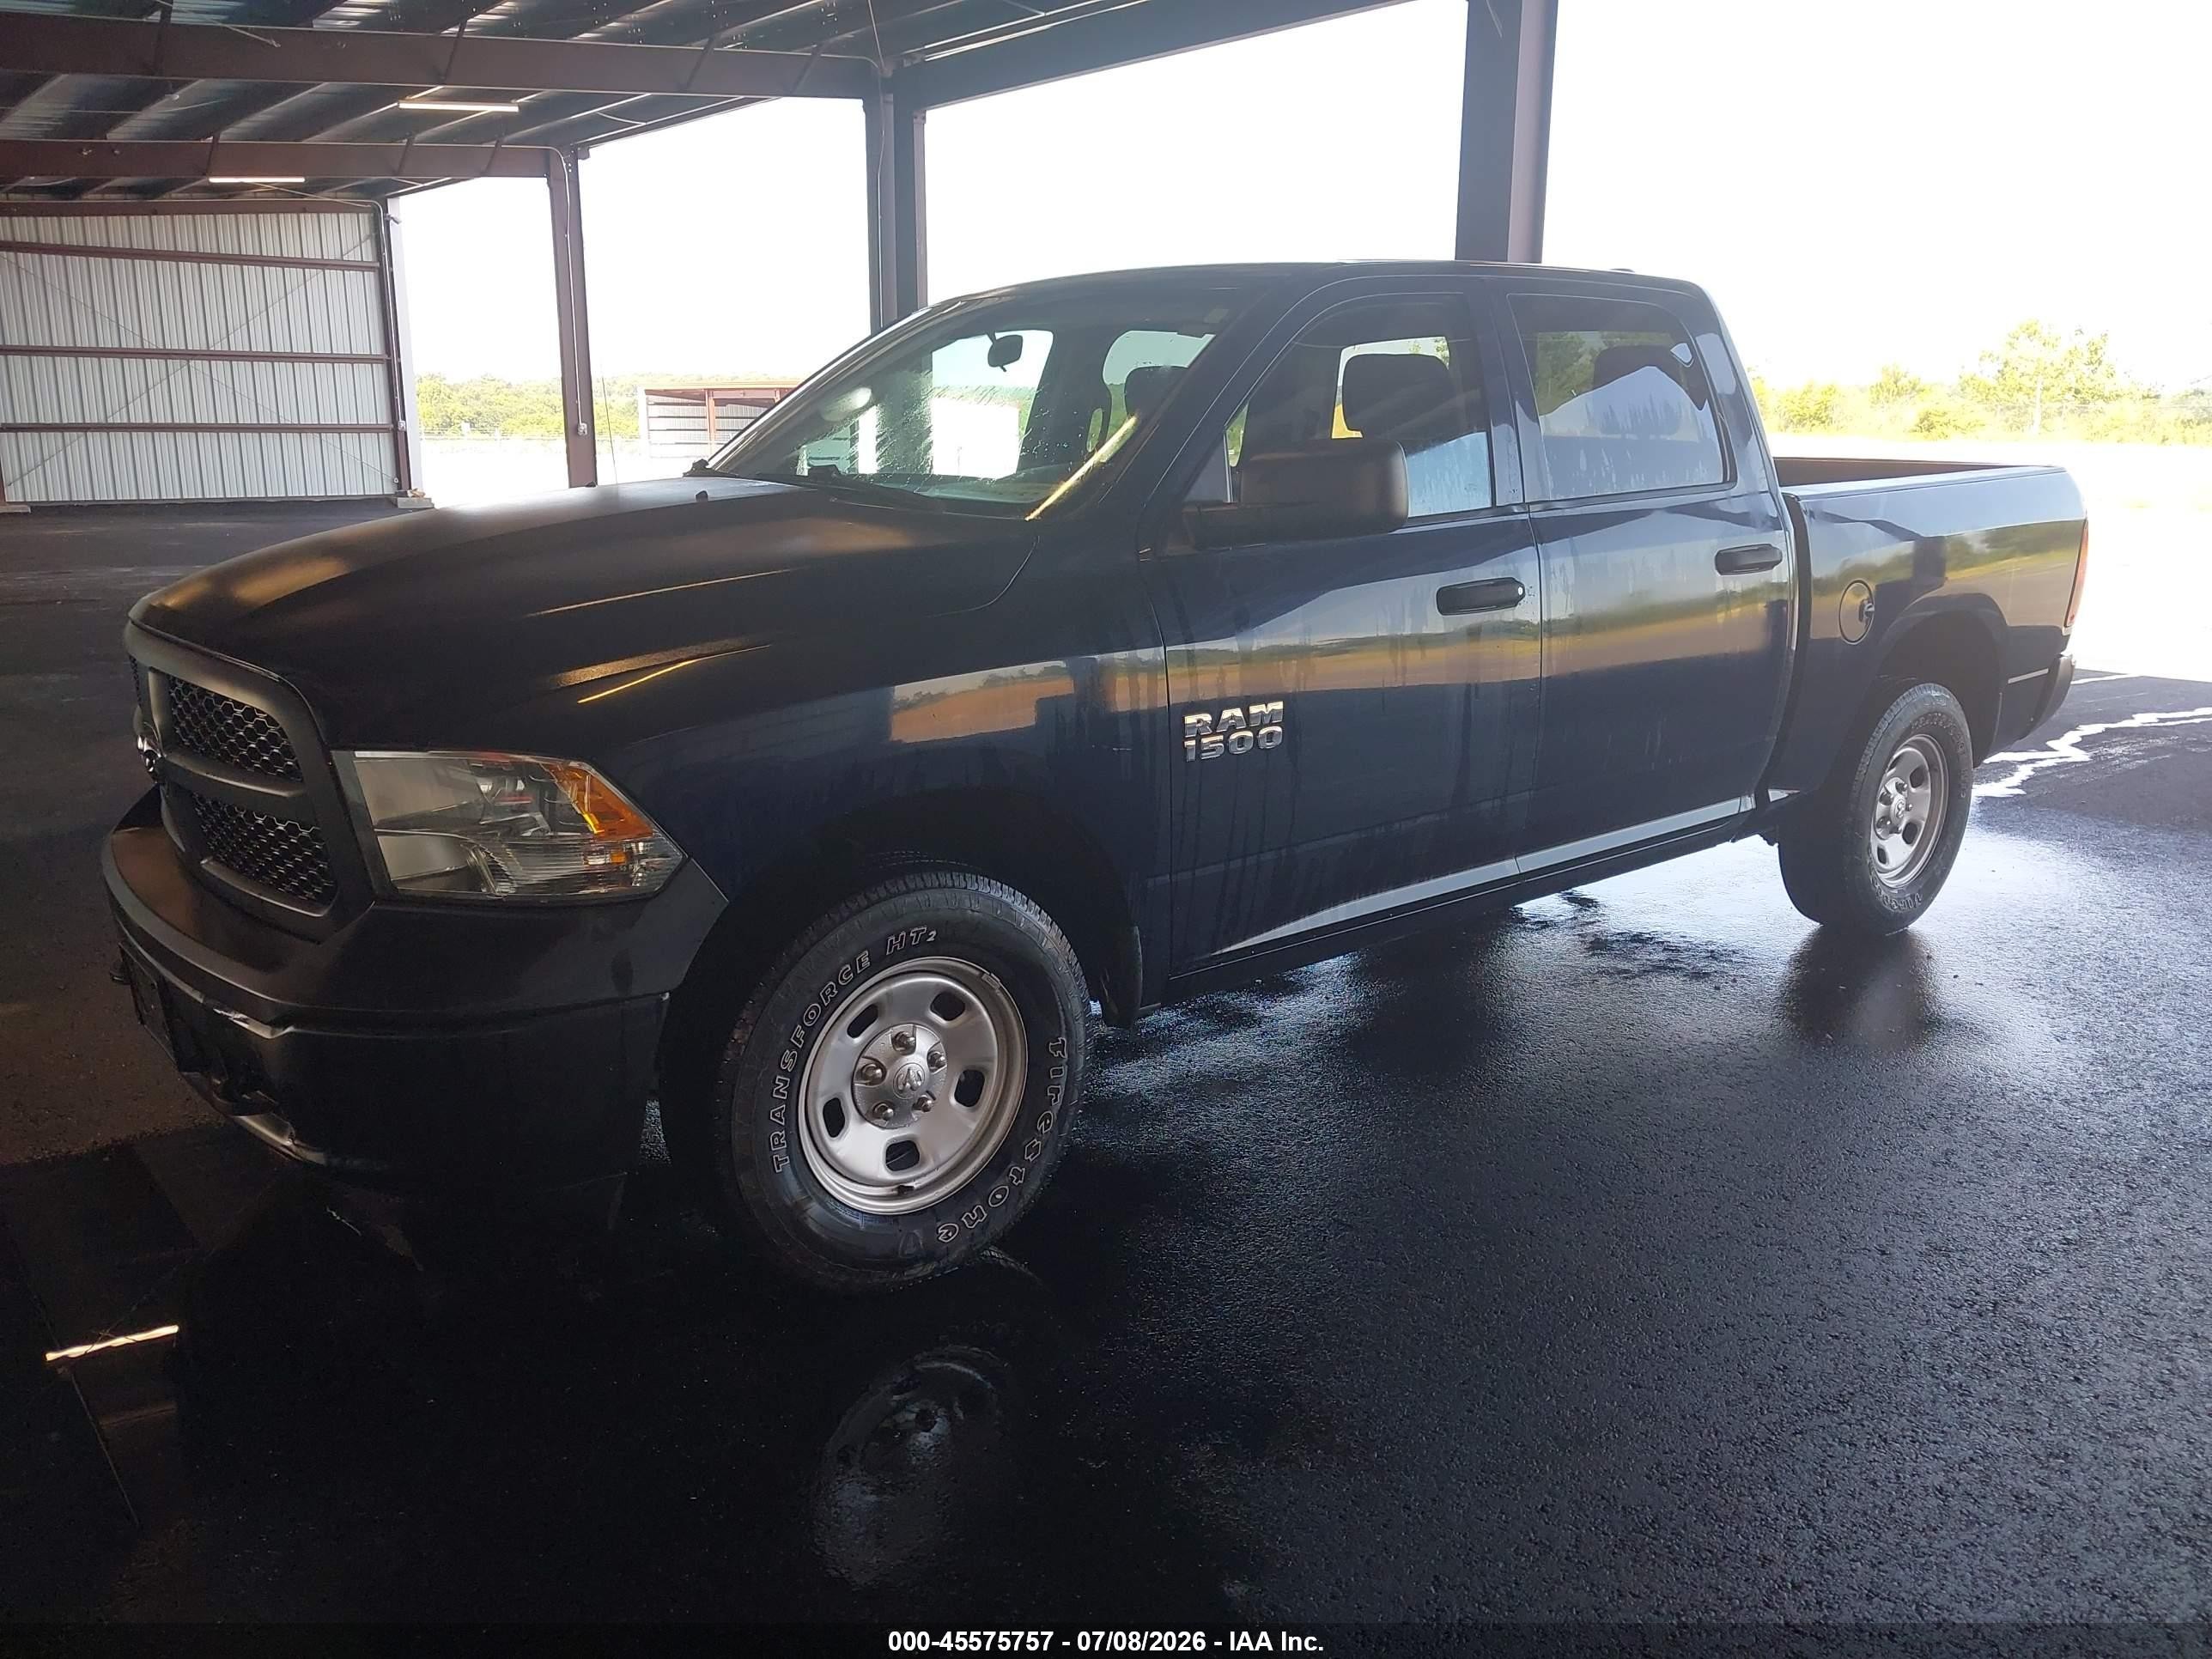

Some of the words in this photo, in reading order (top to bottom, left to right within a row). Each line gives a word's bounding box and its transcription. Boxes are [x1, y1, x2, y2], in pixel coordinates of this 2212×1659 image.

[1183, 701, 1284, 738] RAM
[1183, 726, 1283, 763] 1500
[769, 950, 871, 1174] TRANSFORCE
